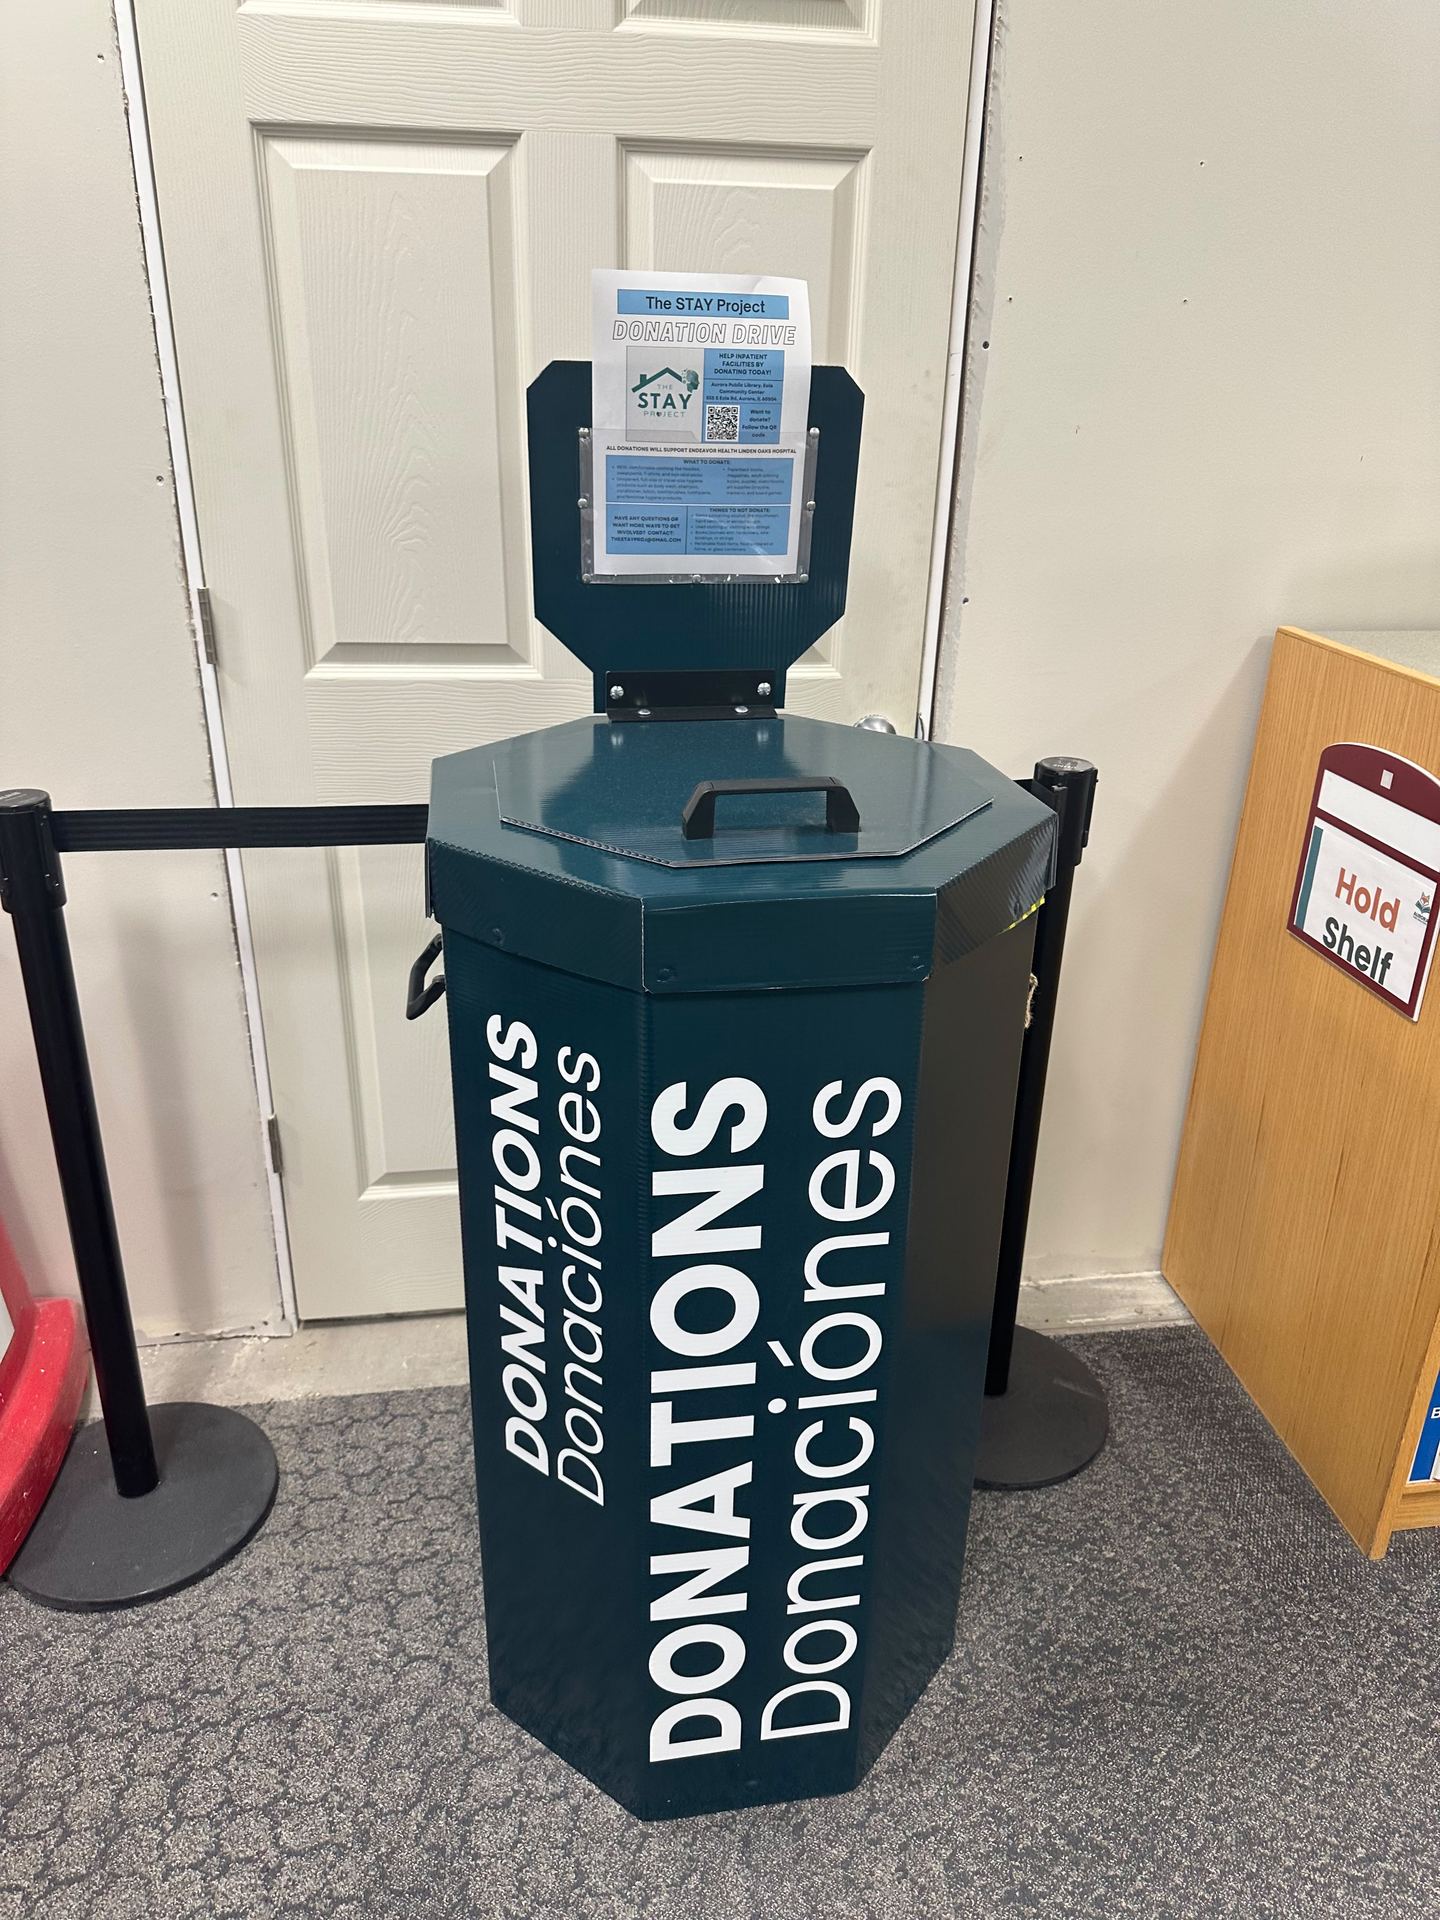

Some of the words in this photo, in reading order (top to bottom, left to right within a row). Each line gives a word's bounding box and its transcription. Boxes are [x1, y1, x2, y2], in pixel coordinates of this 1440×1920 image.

[612, 320, 726, 343] DONATION
[732, 324, 796, 345] DRIVE
[646, 296, 671, 310] The
[676, 297, 713, 311] STAY
[717, 299, 765, 316] Project
[638, 392, 692, 409] STAY
[1335, 867, 1400, 932] Hold
[1323, 916, 1393, 985] Shelf
[487, 1014, 549, 1477] DONATIONS
[545, 1045, 604, 1507] Donaciónes
[649, 1078, 767, 1762] DONATIONS
[760, 1077, 901, 1740] Donaciónes
